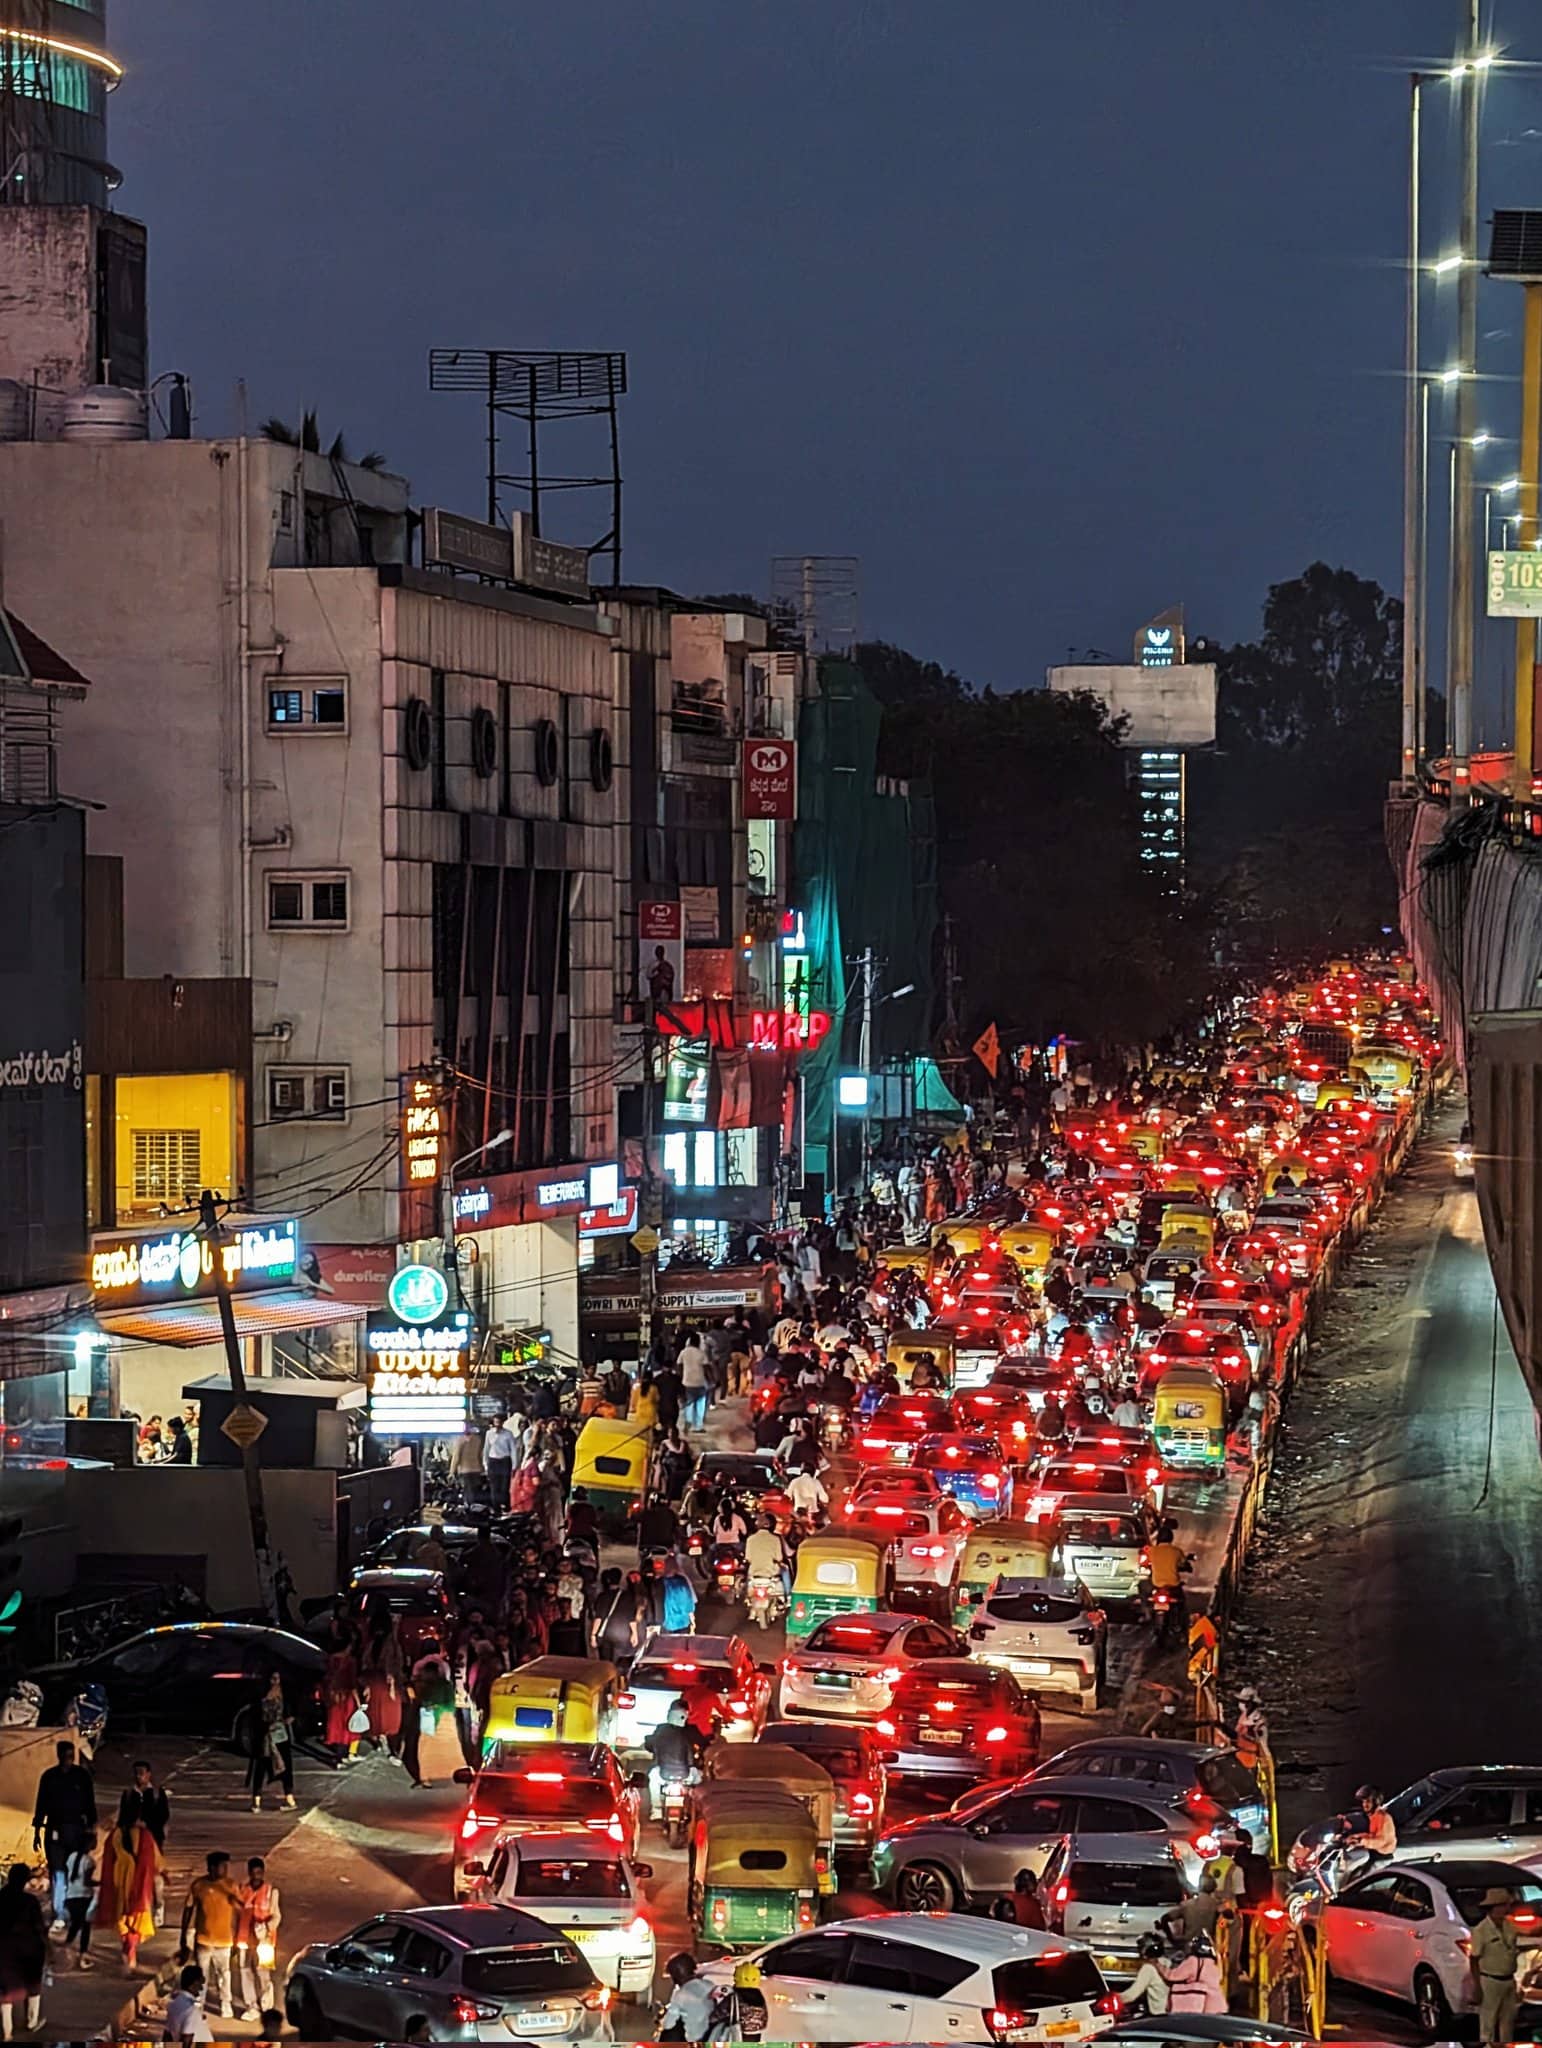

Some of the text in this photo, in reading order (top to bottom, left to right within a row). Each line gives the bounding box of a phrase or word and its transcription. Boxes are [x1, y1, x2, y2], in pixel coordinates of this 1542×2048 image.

[752, 1011, 831, 1050] MRP
[411, 1158, 436, 1179] STUDIO
[334, 1269, 387, 1283] duroflex
[656, 1295, 694, 1308] SUPPLY
[377, 1350, 460, 1372] UDUPI
[371, 1373, 467, 1395] Kitchen
